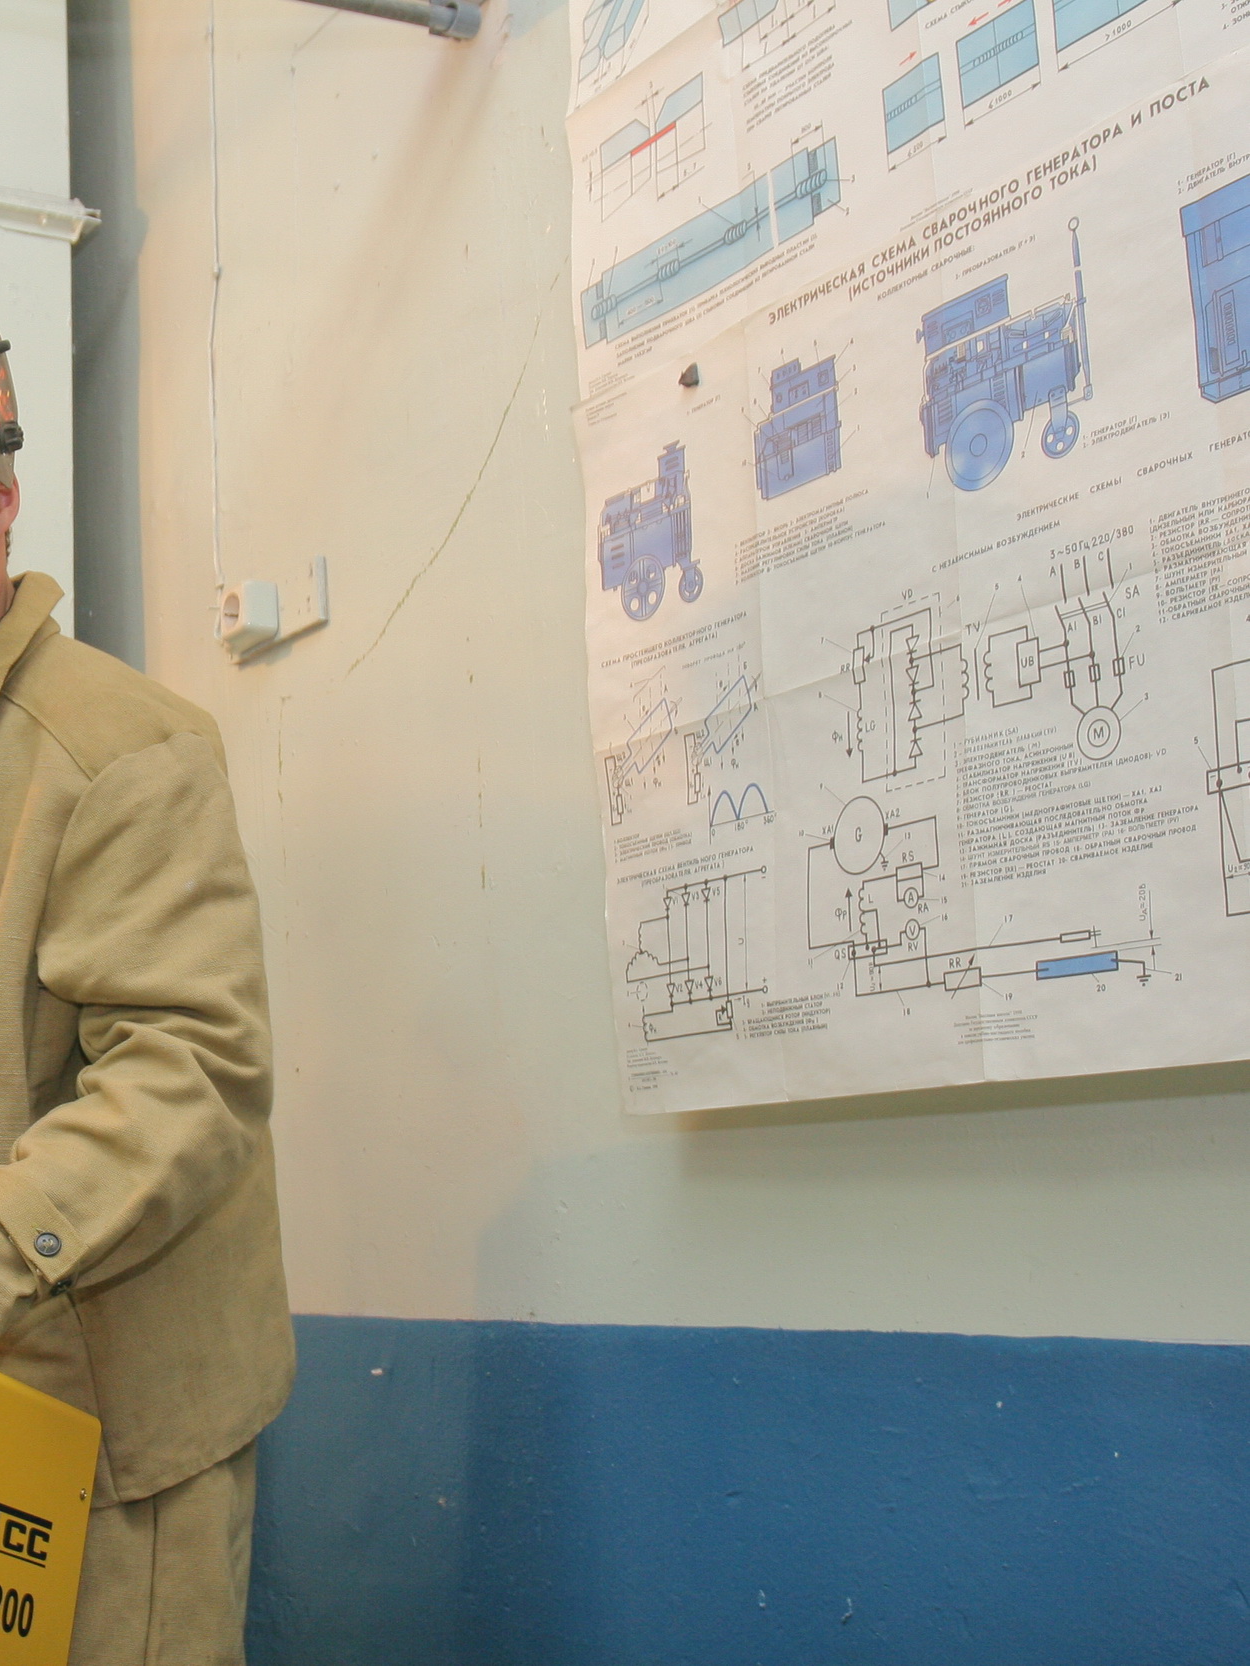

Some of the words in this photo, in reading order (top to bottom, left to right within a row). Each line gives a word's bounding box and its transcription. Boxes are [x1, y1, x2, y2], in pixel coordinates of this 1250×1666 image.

[1186, 159, 1225, 183] ГЕНЕРАТОР
[1187, 167, 1226, 191] ДВИГАТЕЛЬ
[768, 262, 865, 325] ЭЛЕКТРИЧЕСКАЯ
[872, 236, 917, 268] СХЕМА
[922, 178, 1020, 240] СВАРОЧНОГО
[1027, 123, 1123, 185] ГЕНЕРАТОРА
[1131, 110, 1142, 128] И
[1149, 77, 1210, 118] ПОСТА
[934, 185, 1042, 252] ПОСТОЯННОГО
[877, 270, 929, 301] КОЛЛЕКТОРНЫЕ
[1091, 419, 1127, 438] ГЕНЕРАТОР
[1092, 416, 1157, 446] ЭЛЕКТРОДВИГАТЕЛЬ
[1016, 492, 1080, 521] ЭЛЕКТРИЧЕСКИЕ
[1090, 476, 1122, 494] СХЕМЫ
[1137, 452, 1194, 477] СВАРОЧНЫХ
[1158, 505, 1198, 523] ДВИГАТЕЛЬ
[1199, 509, 1214, 517] ИЛИ
[1091, 525, 1135, 548] 220/380
[1159, 523, 1195, 538] РЕЗИСТОР
[939, 543, 994, 570] НЕЗАВИСИМЫМ
[996, 520, 1061, 549] ВОЗБУЖДЕНИЕМ
[1160, 532, 1195, 546] ОБМОТКА
[1161, 533, 1222, 555] ТОКОСЪЕМНИКИ
[1164, 569, 1185, 580] ШУНТ
[1188, 550, 1247, 574] ИЗМЕРИТЕЛЬНЫЙ
[1165, 571, 1208, 588] АМПЕРМЕТР
[902, 589, 913, 600] VD
[1125, 585, 1140, 600] SA
[1165, 580, 1207, 597] ВОЛЬТМЕТР
[1170, 589, 1206, 604] РЕЗИСТОР
[1172, 601, 1222, 621] СВАРИВАЕМОЕ
[966, 621, 981, 636] TV
[1136, 625, 1141, 633] 2
[1021, 657, 1035, 669] UB
[1128, 653, 1146, 670] FU
[865, 720, 876, 733] LG
[1157, 805, 1199, 818] ГЕНЕРАТОРА
[1169, 825, 1197, 835] ПРОВОД
[718, 846, 754, 860] ГЕНЕРАТОРА
[902, 852, 915, 862] RS
[1005, 915, 1013, 923] 17
[835, 950, 846, 960] QS
[949, 957, 962, 968] RR
[1097, 984, 1106, 992] 20
